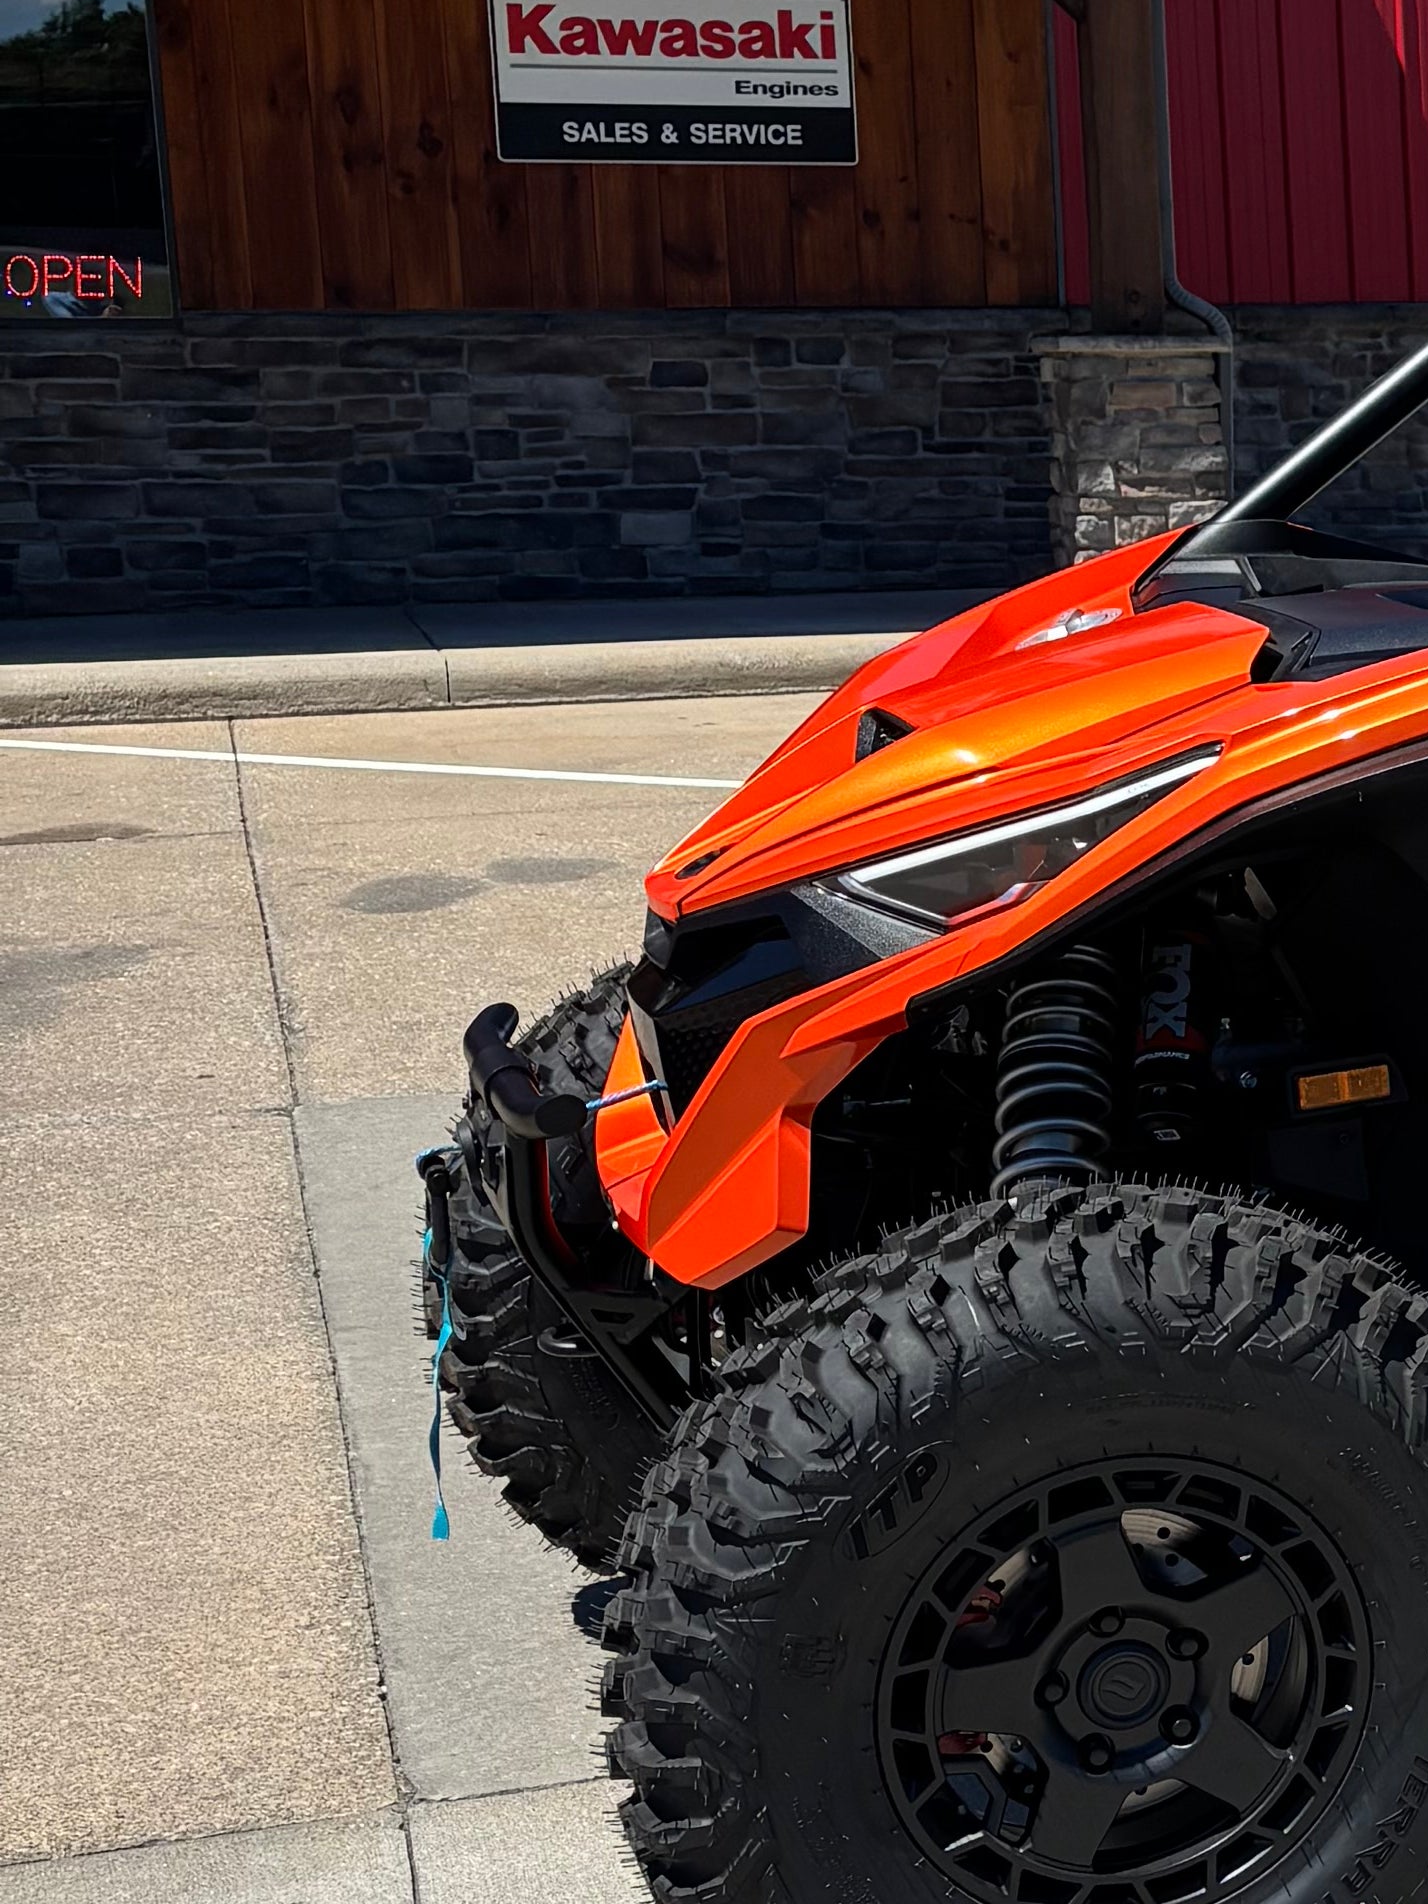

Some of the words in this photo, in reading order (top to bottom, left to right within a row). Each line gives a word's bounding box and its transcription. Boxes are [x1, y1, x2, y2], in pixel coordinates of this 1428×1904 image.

[505, 2, 837, 61] Kawasaki
[734, 79, 839, 100] Engines
[562, 120, 650, 146] SALES
[660, 122, 680, 145] &
[689, 122, 804, 147] SERVICE
[5, 253, 144, 302] OPEN
[1143, 942, 1193, 1041] FOX
[847, 1451, 939, 1561] ITP
